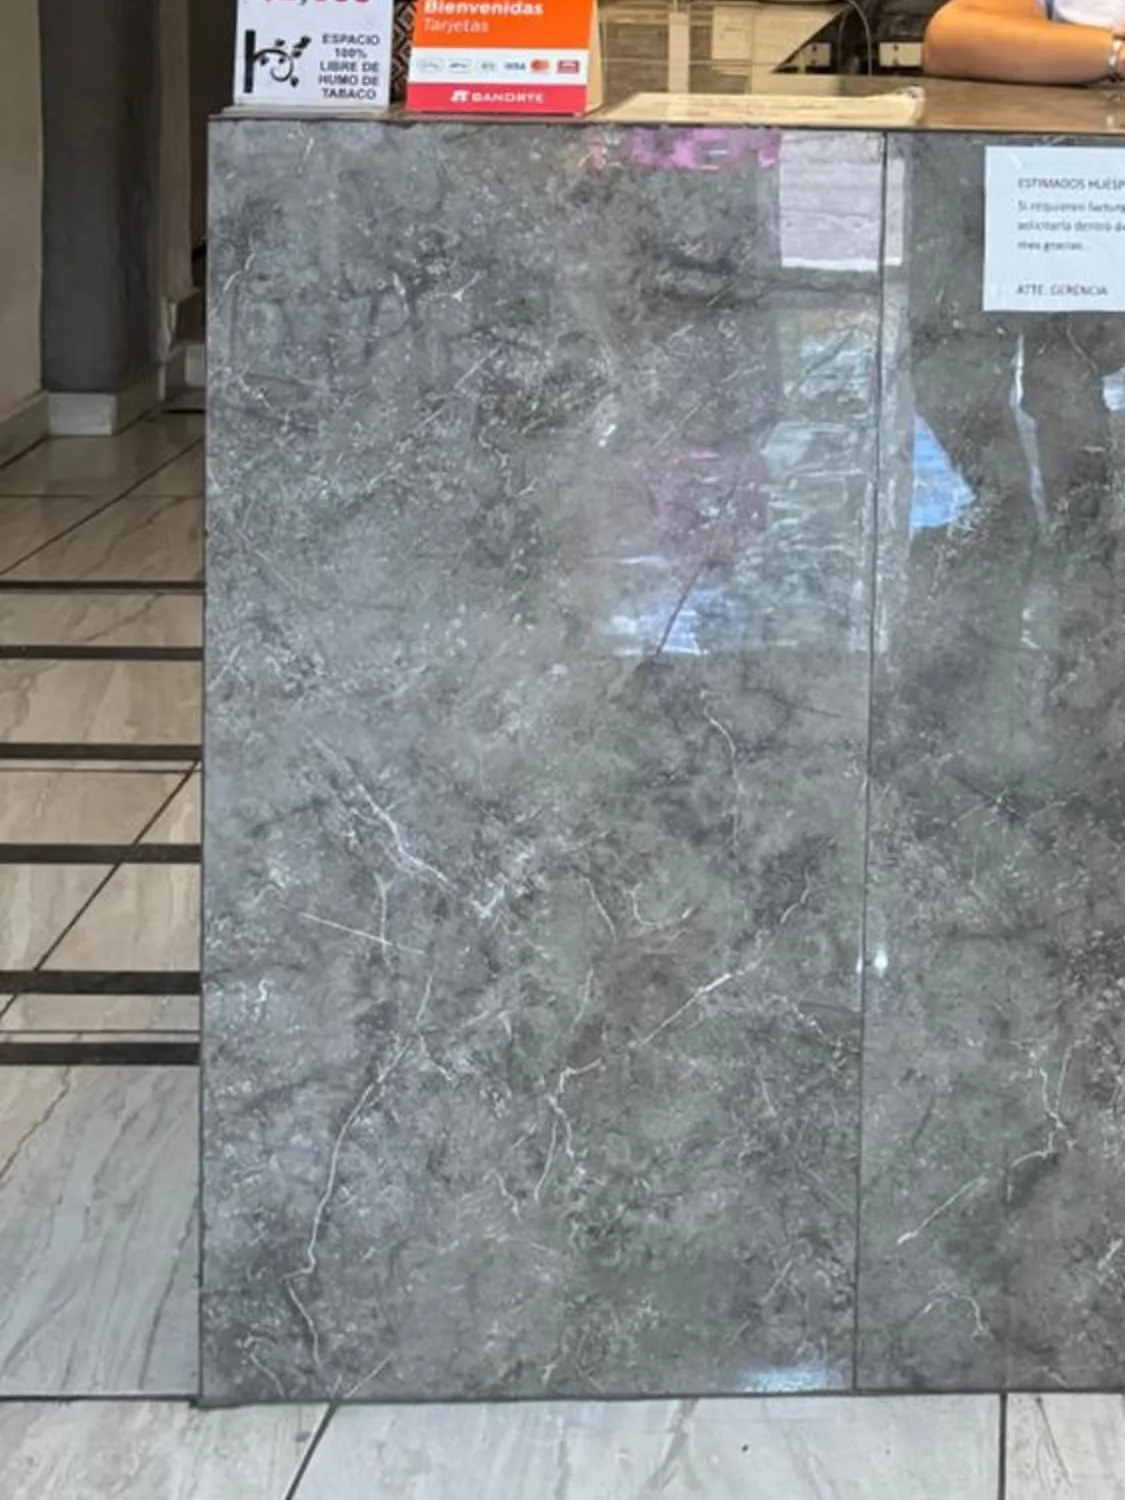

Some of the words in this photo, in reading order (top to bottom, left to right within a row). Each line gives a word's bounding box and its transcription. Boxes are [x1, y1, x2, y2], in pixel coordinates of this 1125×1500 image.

[423, 0, 544, 16] Bienvenidas
[423, 17, 489, 36] Tarjetas
[322, 33, 380, 47] ESPACIO
[334, 47, 367, 60] 100%
[320, 61, 357, 74] LIBRE
[363, 61, 380, 74] DE
[318, 74, 358, 88] HUMO
[362, 75, 380, 88] DE
[322, 88, 376, 101] TABACO
[471, 92, 544, 105] BANORTE
[1018, 178, 1086, 191] ESTIMADOS
[1050, 284, 1108, 297] GERENCIA
